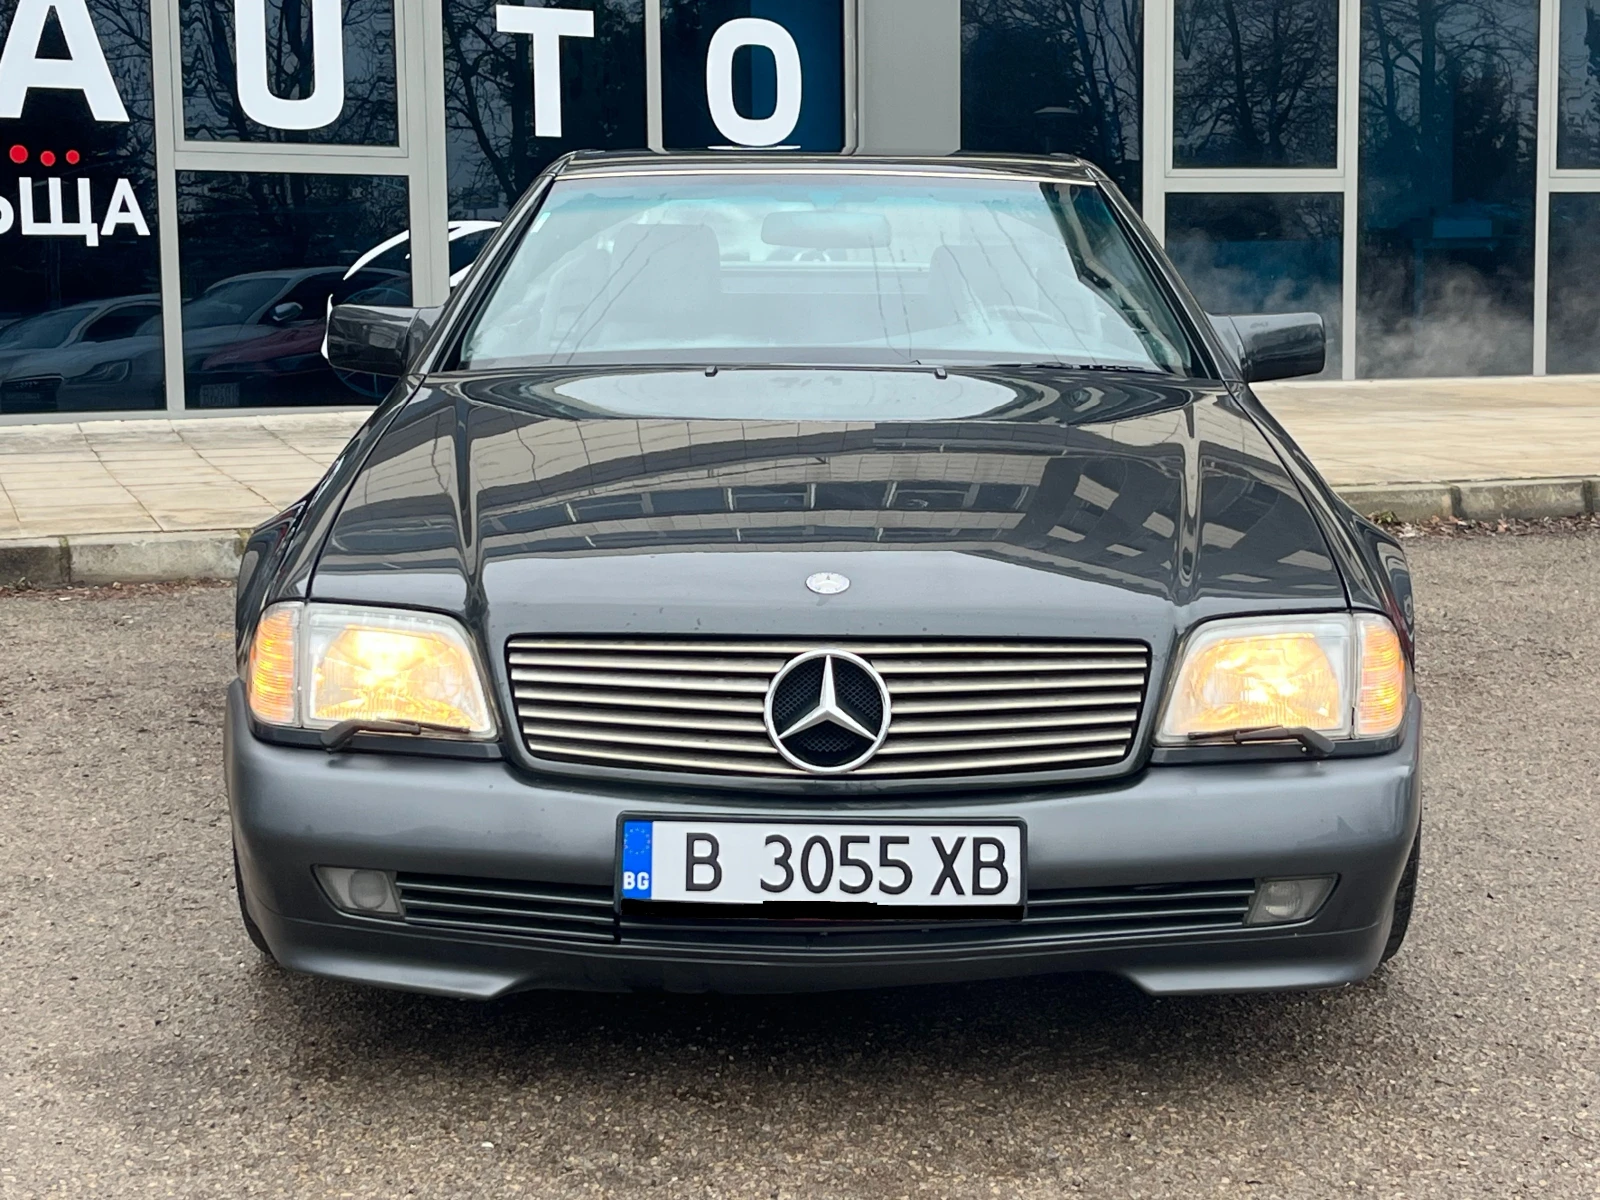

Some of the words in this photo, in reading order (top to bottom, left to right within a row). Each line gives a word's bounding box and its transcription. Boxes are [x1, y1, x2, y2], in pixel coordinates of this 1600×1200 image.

[622, 871, 650, 890] BG
[685, 832, 723, 892] B
[760, 834, 913, 896] 3055
[930, 836, 1009, 896] XB
